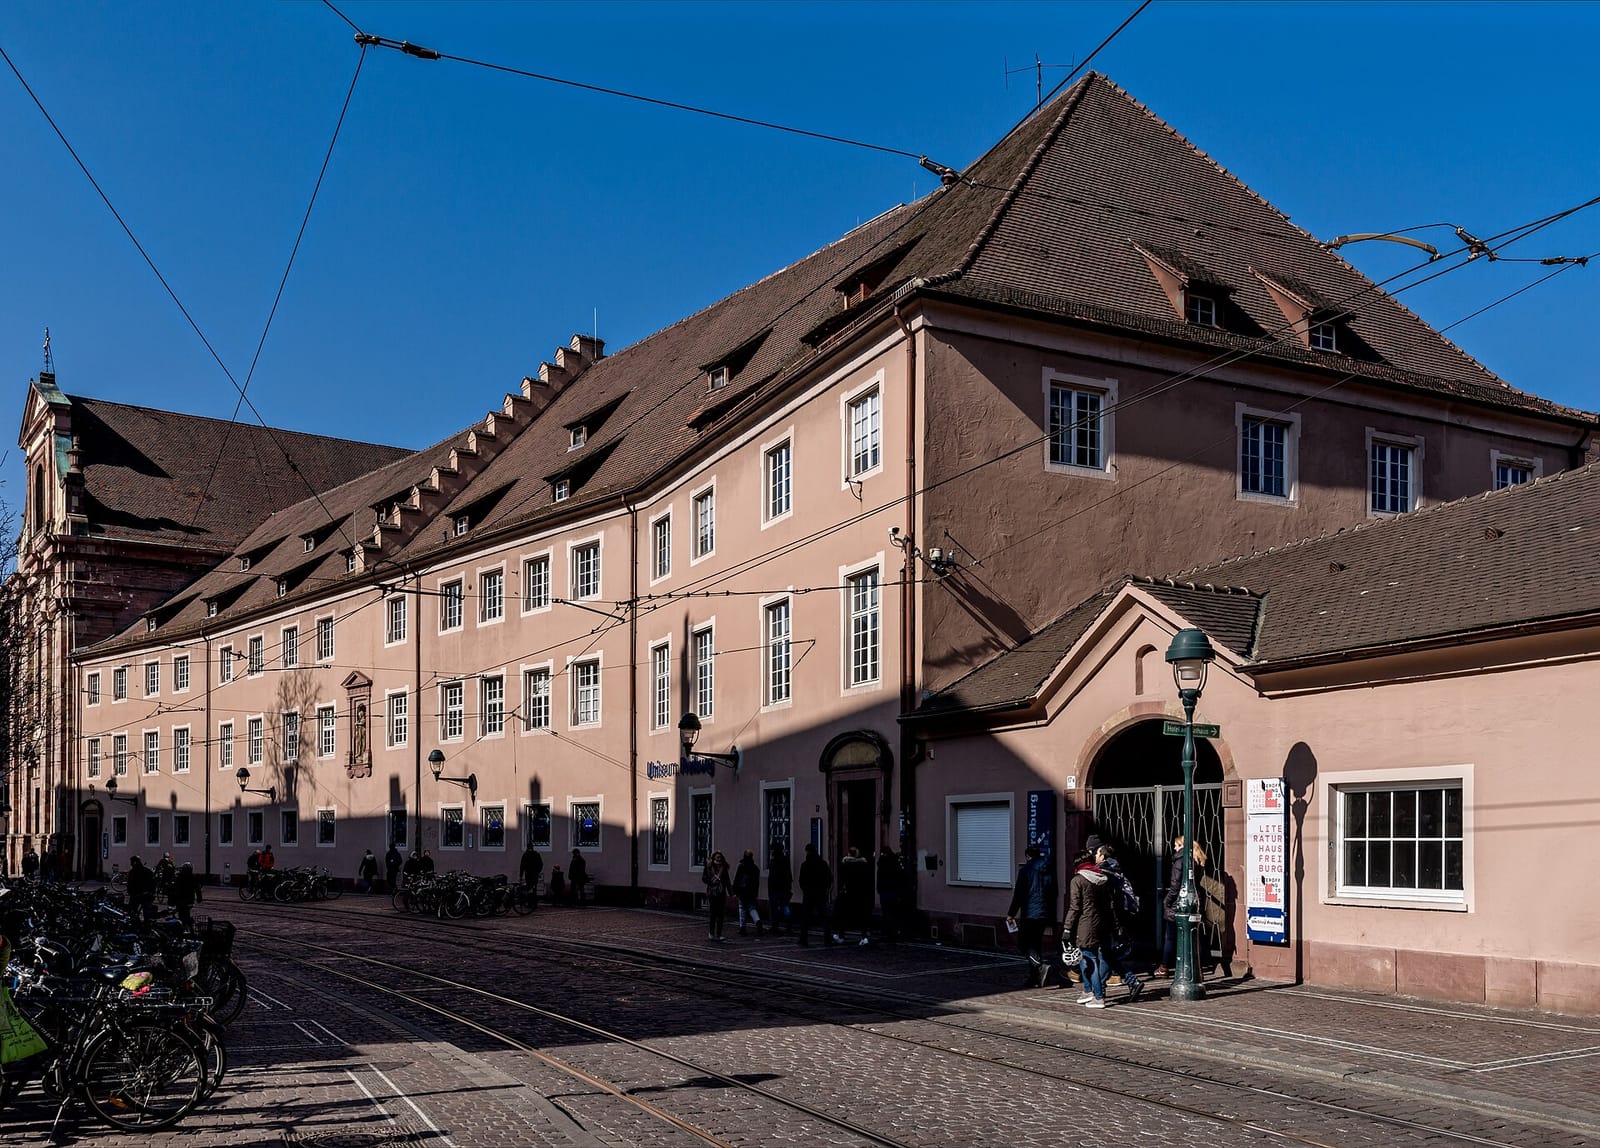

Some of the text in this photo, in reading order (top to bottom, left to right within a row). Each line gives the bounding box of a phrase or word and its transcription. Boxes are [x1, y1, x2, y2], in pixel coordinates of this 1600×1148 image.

[647, 760, 679, 778] Uniseum
[1028, 793, 1039, 847] reiburg
[1259, 825, 1282, 833] LITE
[1253, 834, 1283, 843] RATUR
[1258, 845, 1282, 853] HAUS
[1258, 855, 1282, 863] FREI
[1258, 864, 1283, 873] BURG
